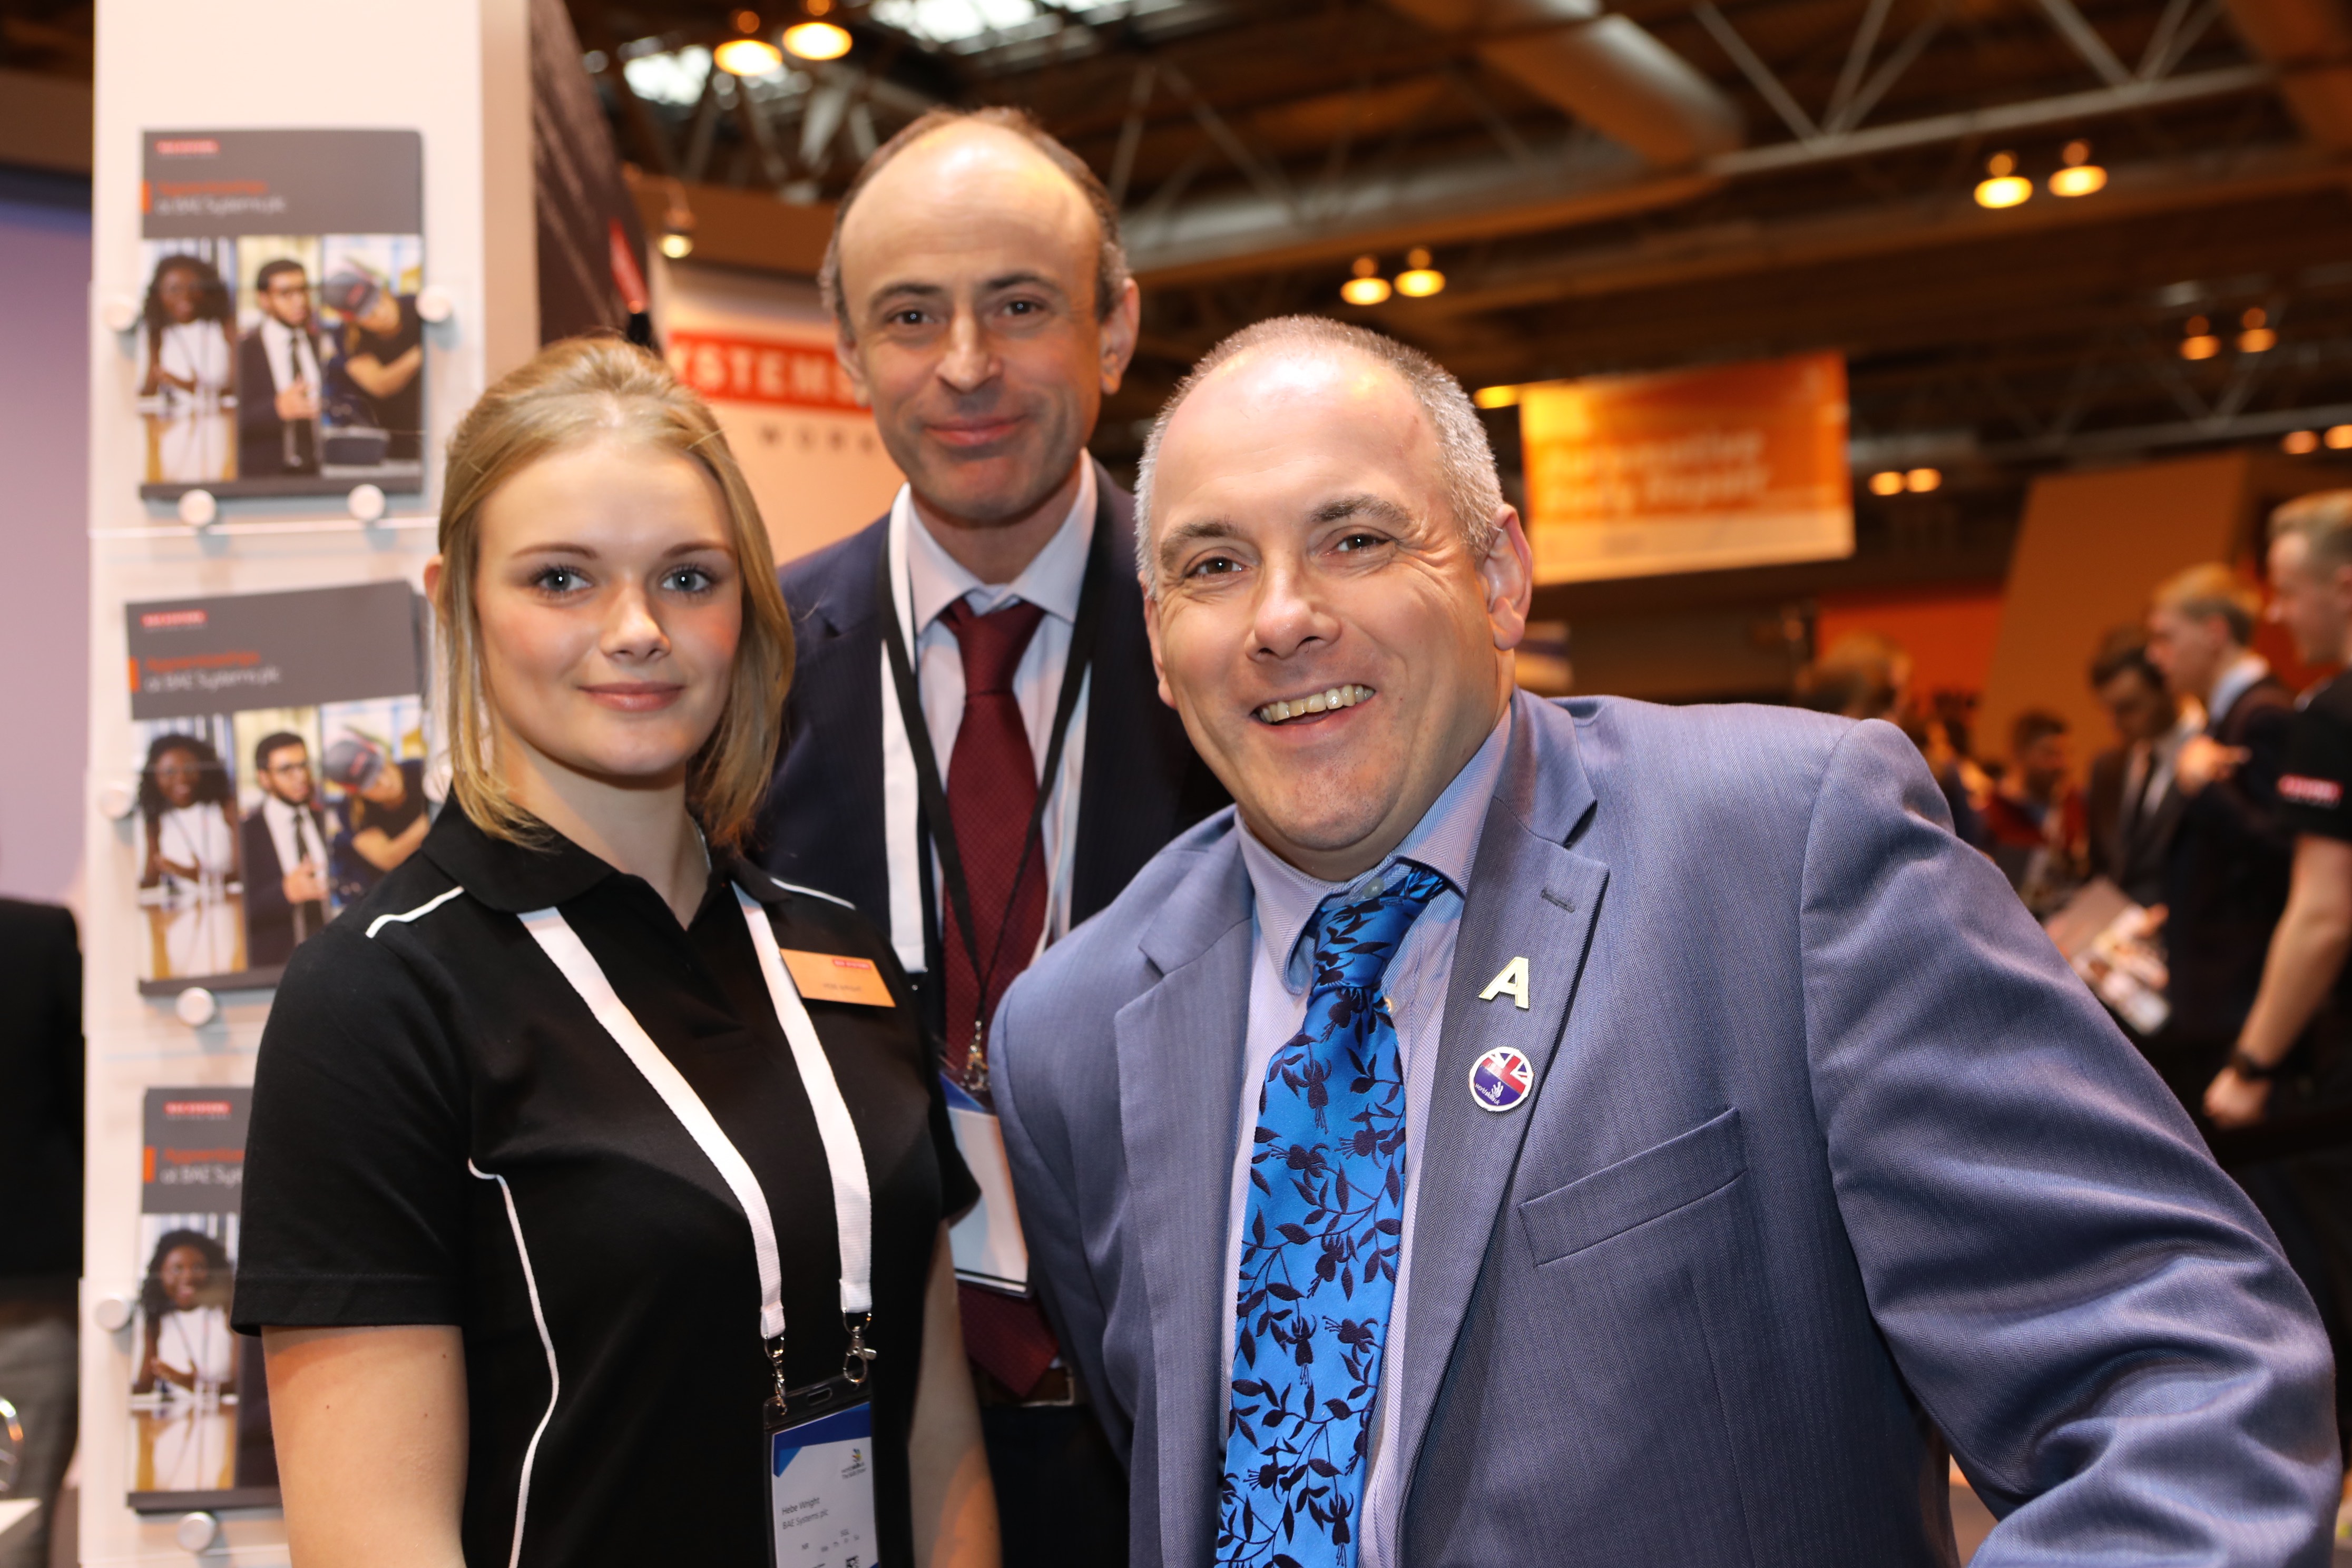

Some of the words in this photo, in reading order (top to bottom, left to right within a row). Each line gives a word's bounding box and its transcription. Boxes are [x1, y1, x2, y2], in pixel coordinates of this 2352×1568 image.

[1478, 956, 1529, 1009] A
[782, 1504, 798, 1515] Hebe
[799, 1497, 820, 1510] Wright
[782, 1519, 795, 1530] BAE
[796, 1513, 820, 1527] Systems
